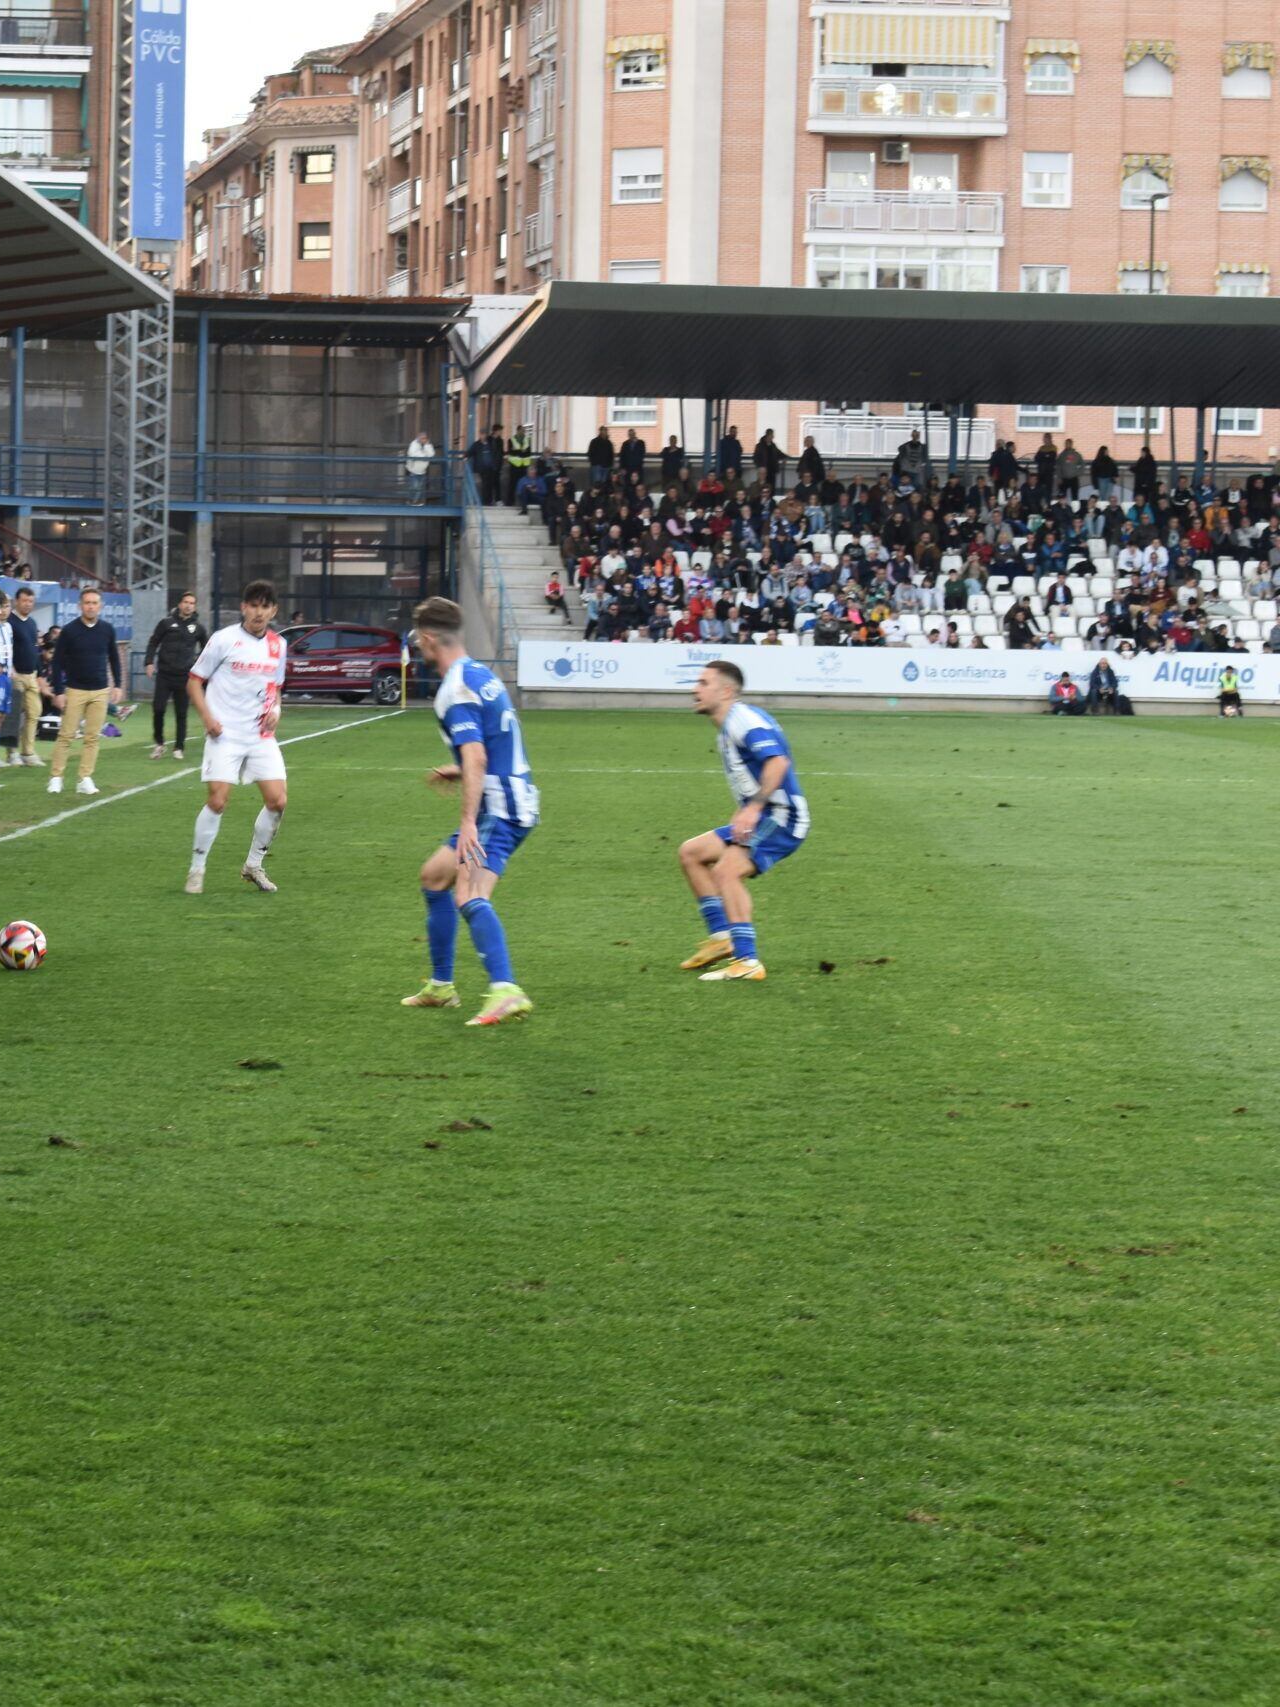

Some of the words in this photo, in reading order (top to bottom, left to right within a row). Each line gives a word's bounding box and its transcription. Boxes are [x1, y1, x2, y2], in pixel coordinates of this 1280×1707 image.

[139, 28, 181, 45] Cálida
[139, 44, 182, 64] PVC
[154, 81, 165, 130] ventanas
[924, 665, 938, 678] la
[941, 665, 1008, 678] confianza
